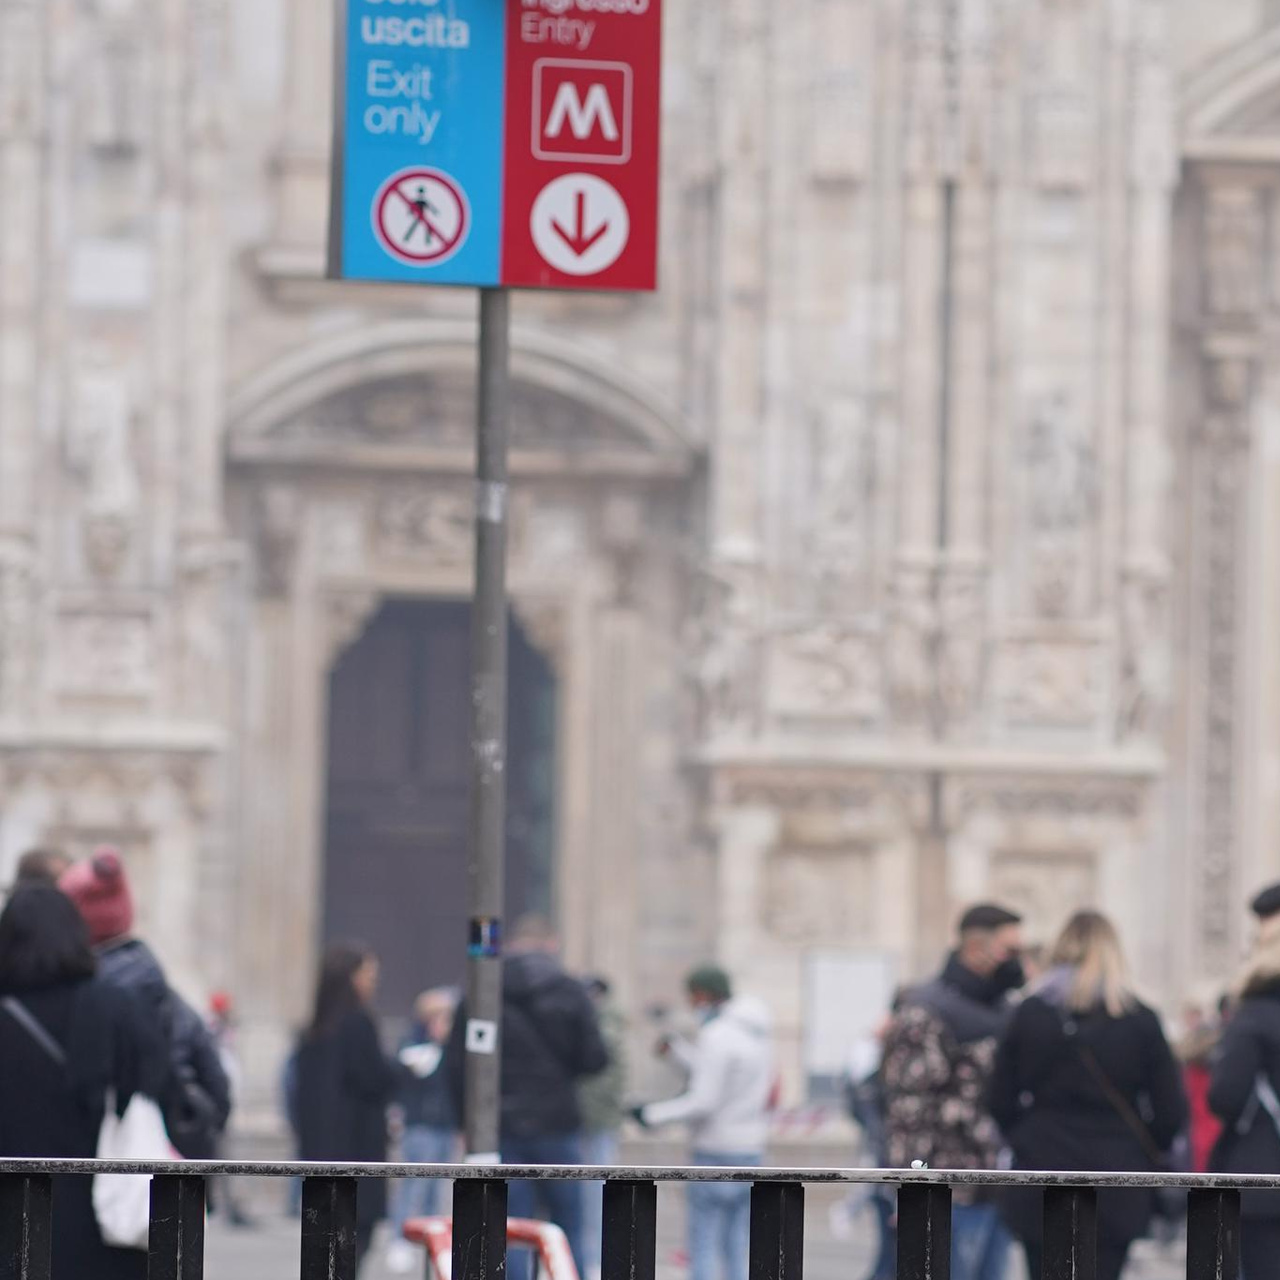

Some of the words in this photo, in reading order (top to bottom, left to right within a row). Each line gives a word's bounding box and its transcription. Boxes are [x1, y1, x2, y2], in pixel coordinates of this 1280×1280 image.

[361, 17, 469, 48] uscita
[522, 14, 595, 49] Entry
[367, 61, 433, 100] Exit
[364, 102, 440, 144] only
[546, 82, 618, 139] M
